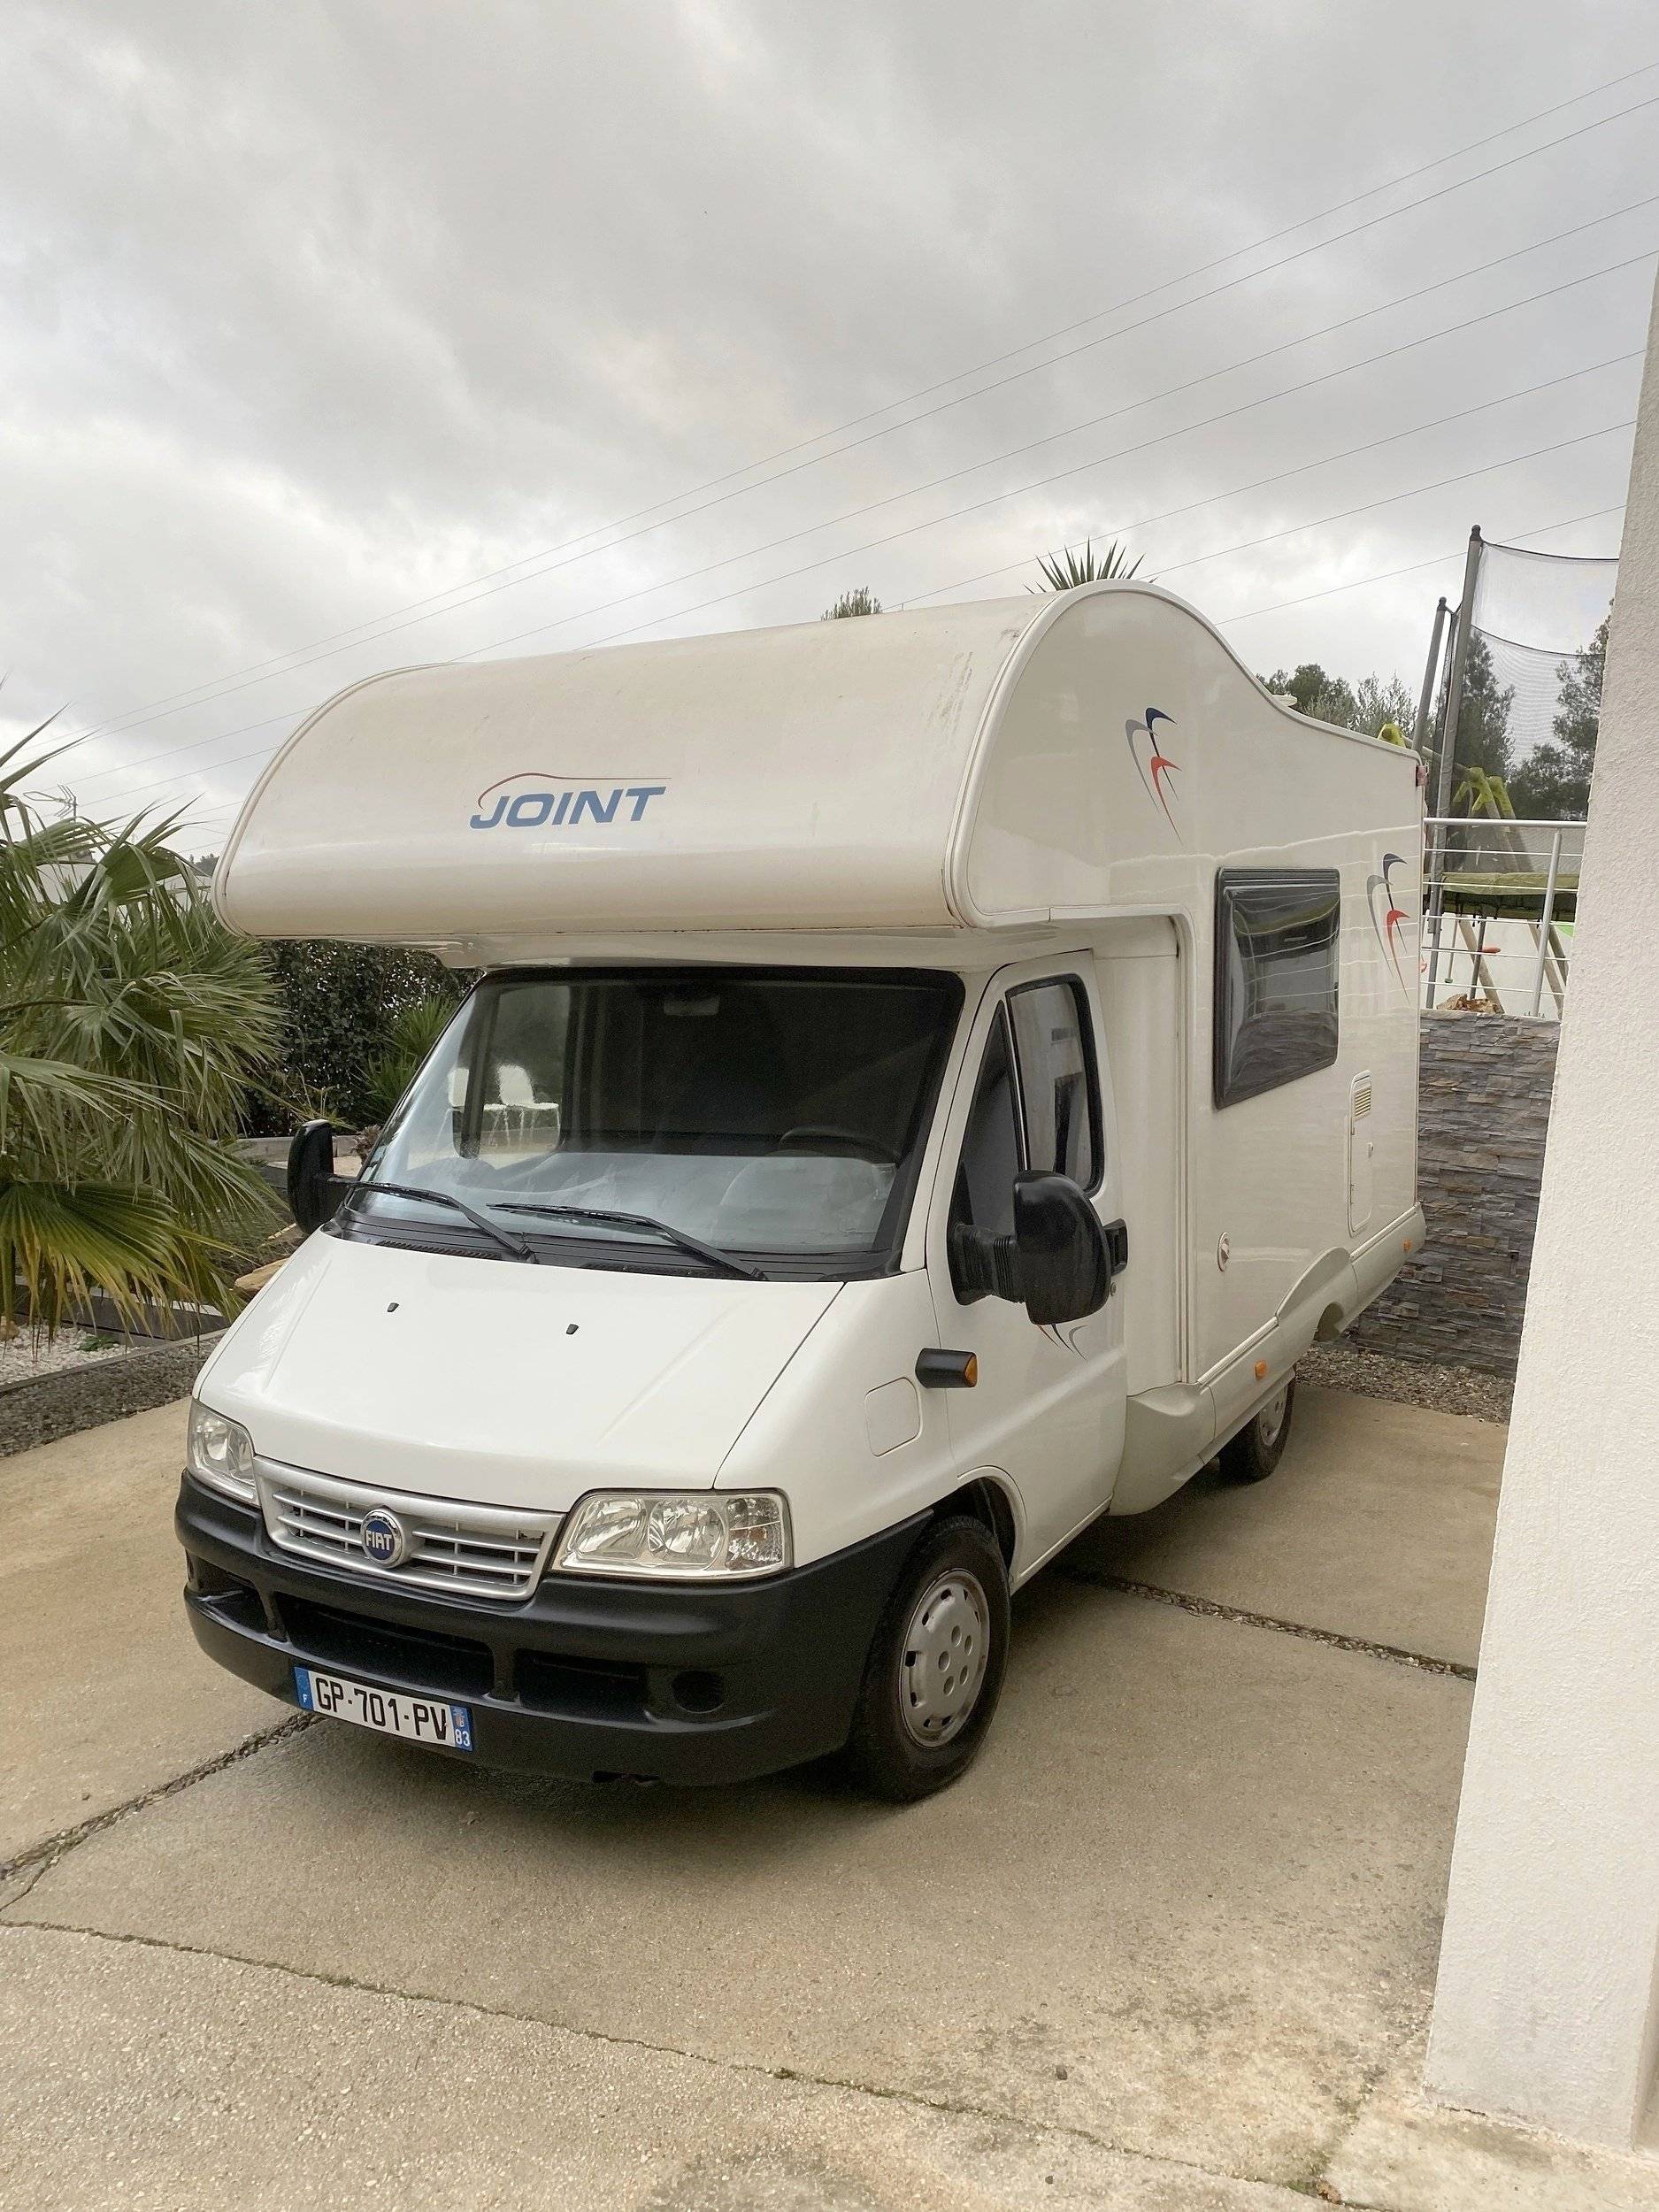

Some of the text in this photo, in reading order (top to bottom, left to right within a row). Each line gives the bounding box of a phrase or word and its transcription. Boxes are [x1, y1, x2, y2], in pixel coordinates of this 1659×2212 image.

[469, 786, 667, 830] JOINT
[365, 1529, 393, 1551] FIAT
[302, 1694, 308, 1703] F
[315, 1677, 447, 1740] GP-701-PV
[455, 1728, 471, 1747] 83
